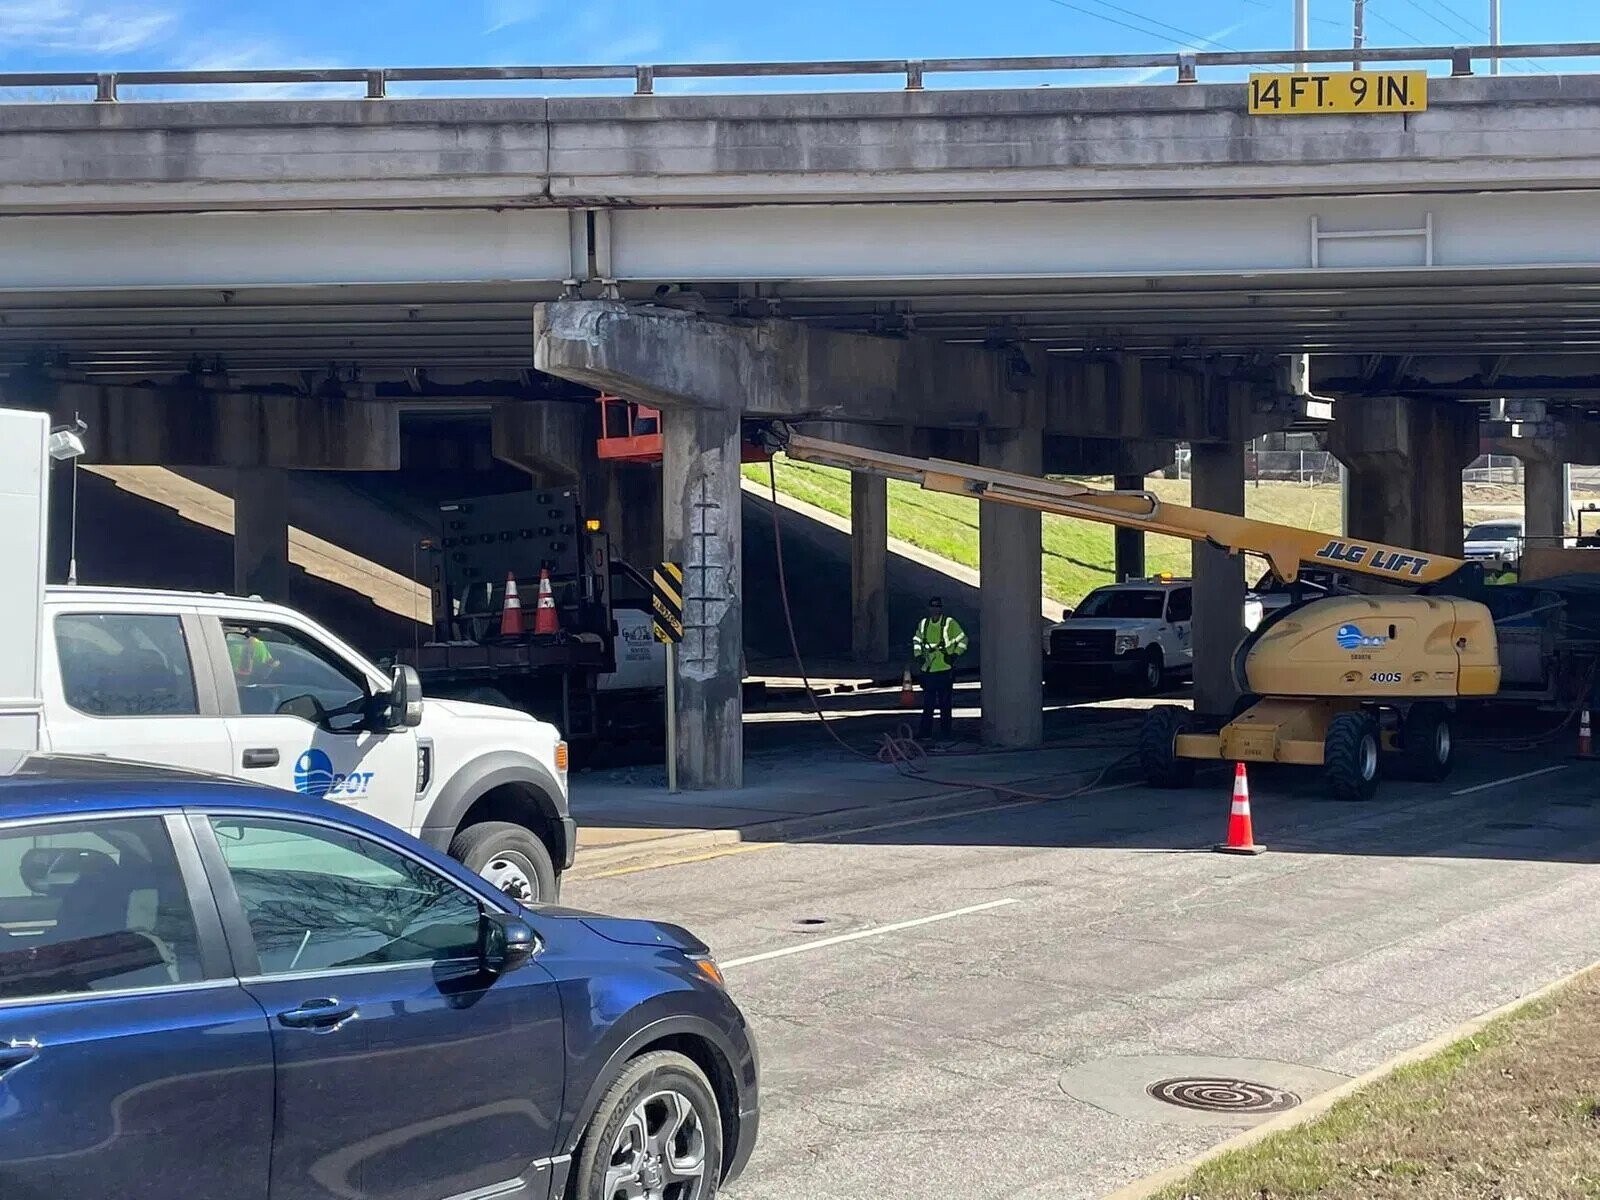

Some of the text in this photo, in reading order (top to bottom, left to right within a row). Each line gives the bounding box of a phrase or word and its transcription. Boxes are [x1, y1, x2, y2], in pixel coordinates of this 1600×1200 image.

[1251, 76, 1415, 109] 14 FT. 9 IN.
[1315, 541, 1430, 575] JLG LIFT
[1369, 672, 1402, 682] 400S
